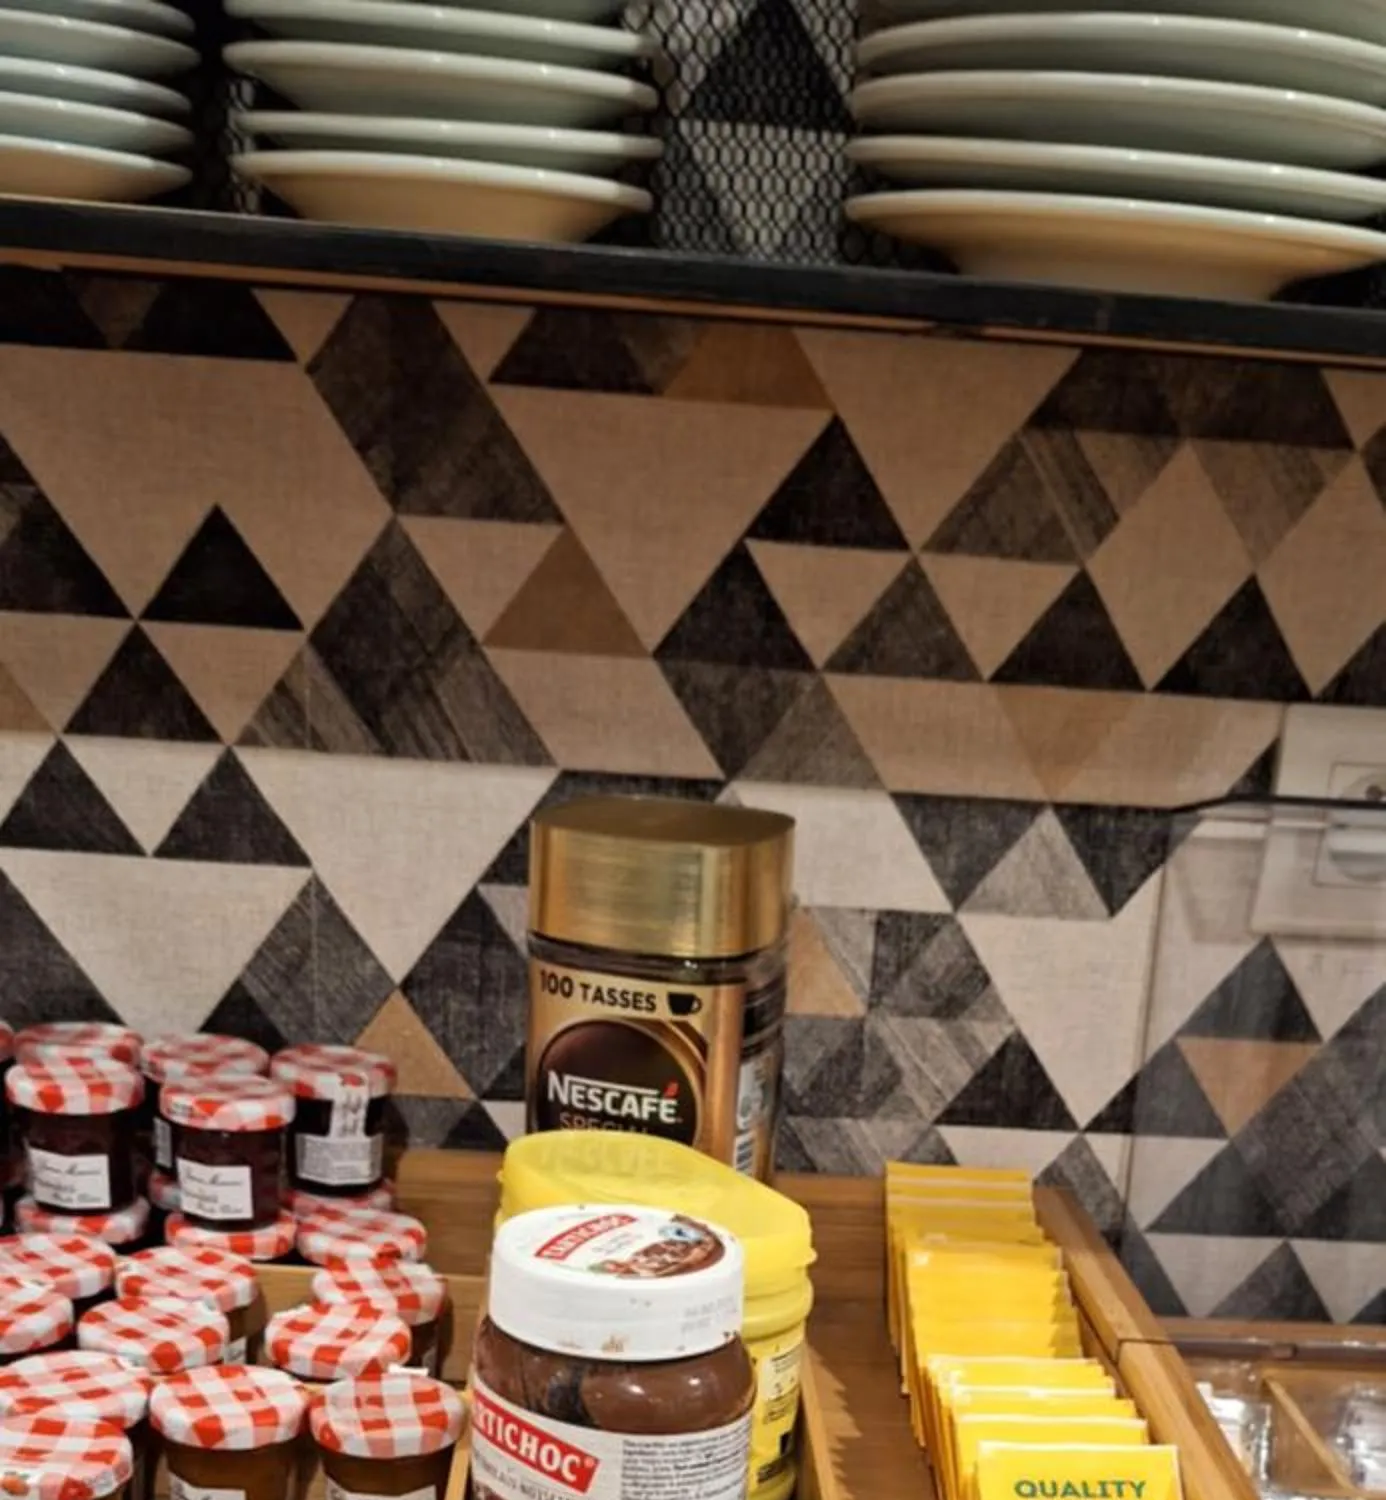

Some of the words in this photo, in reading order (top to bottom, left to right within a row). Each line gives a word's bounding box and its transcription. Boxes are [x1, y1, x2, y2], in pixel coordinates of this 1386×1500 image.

[540, 969, 574, 998] 100
[579, 983, 657, 1013] TASSES
[547, 1070, 680, 1124] NESCAFÉ
[559, 1111, 650, 1134] SPEC
[1014, 1479, 1146, 1499] QUALITY
